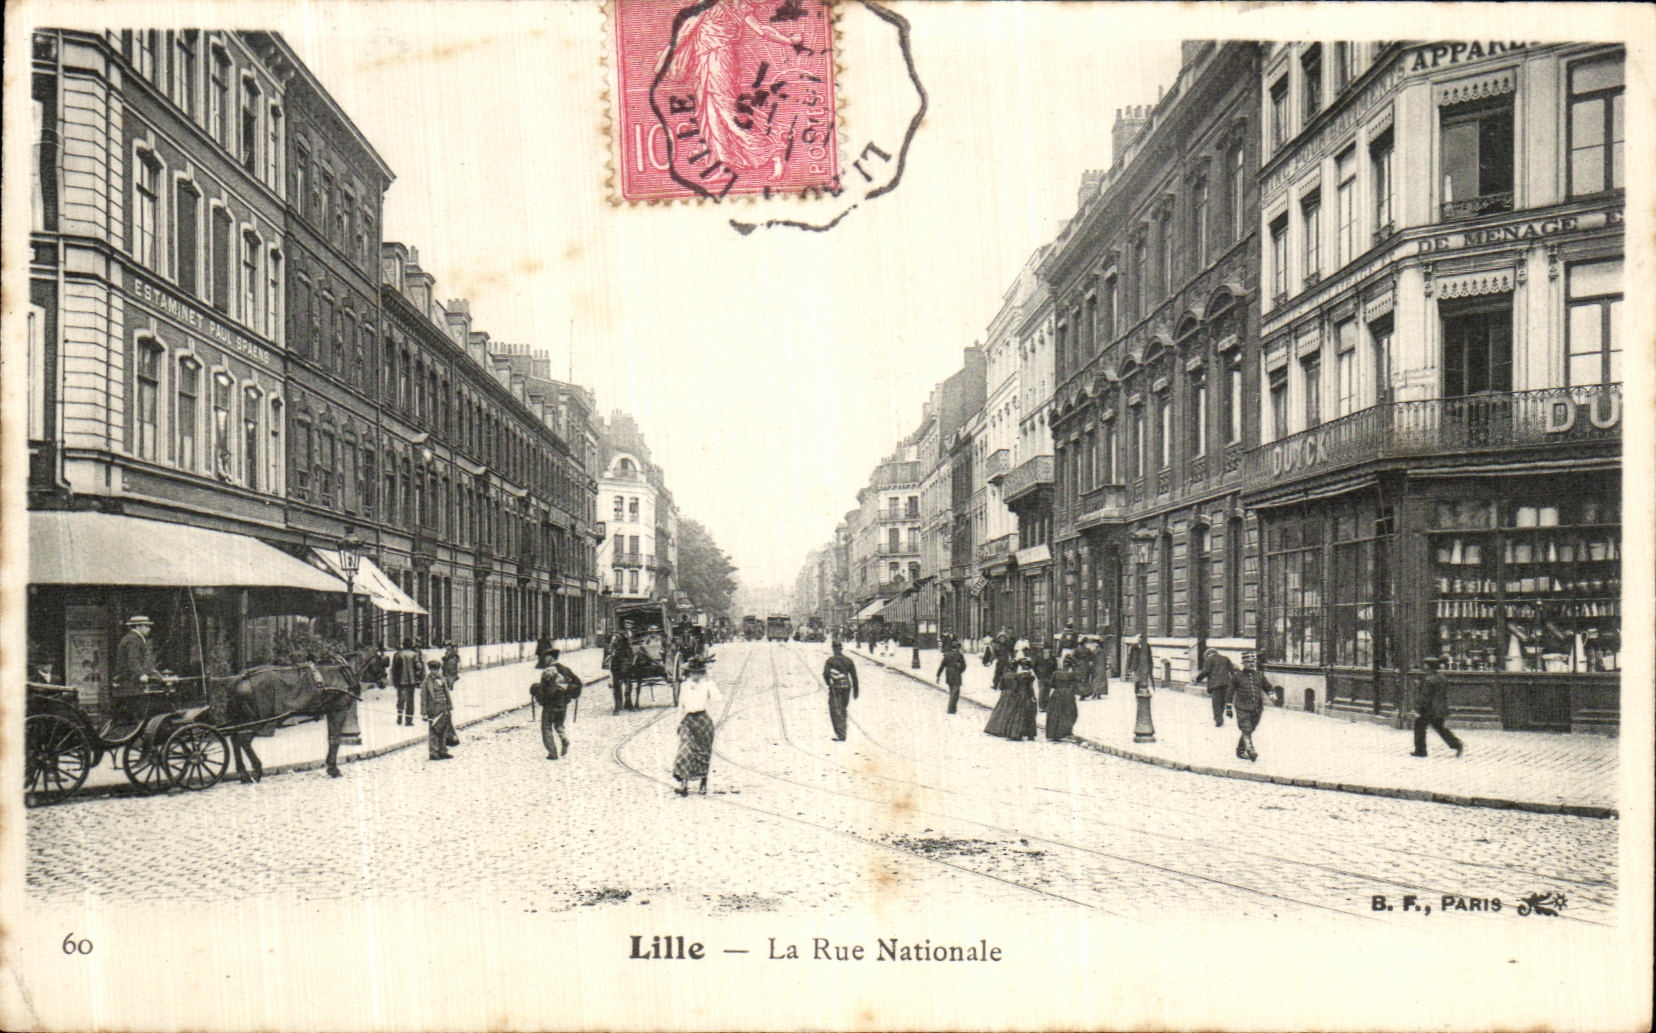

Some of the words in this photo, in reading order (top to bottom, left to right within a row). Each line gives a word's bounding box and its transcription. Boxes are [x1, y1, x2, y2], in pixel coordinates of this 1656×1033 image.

[669, 94, 738, 200] LILLE
[807, 91, 827, 175] POSTES
[1417, 236, 1449, 255] DE
[1464, 216, 1579, 247] MENAGE
[134, 278, 204, 329] ESTAMINET
[209, 321, 232, 345] PAUL
[1273, 431, 1329, 477] DUYCK
